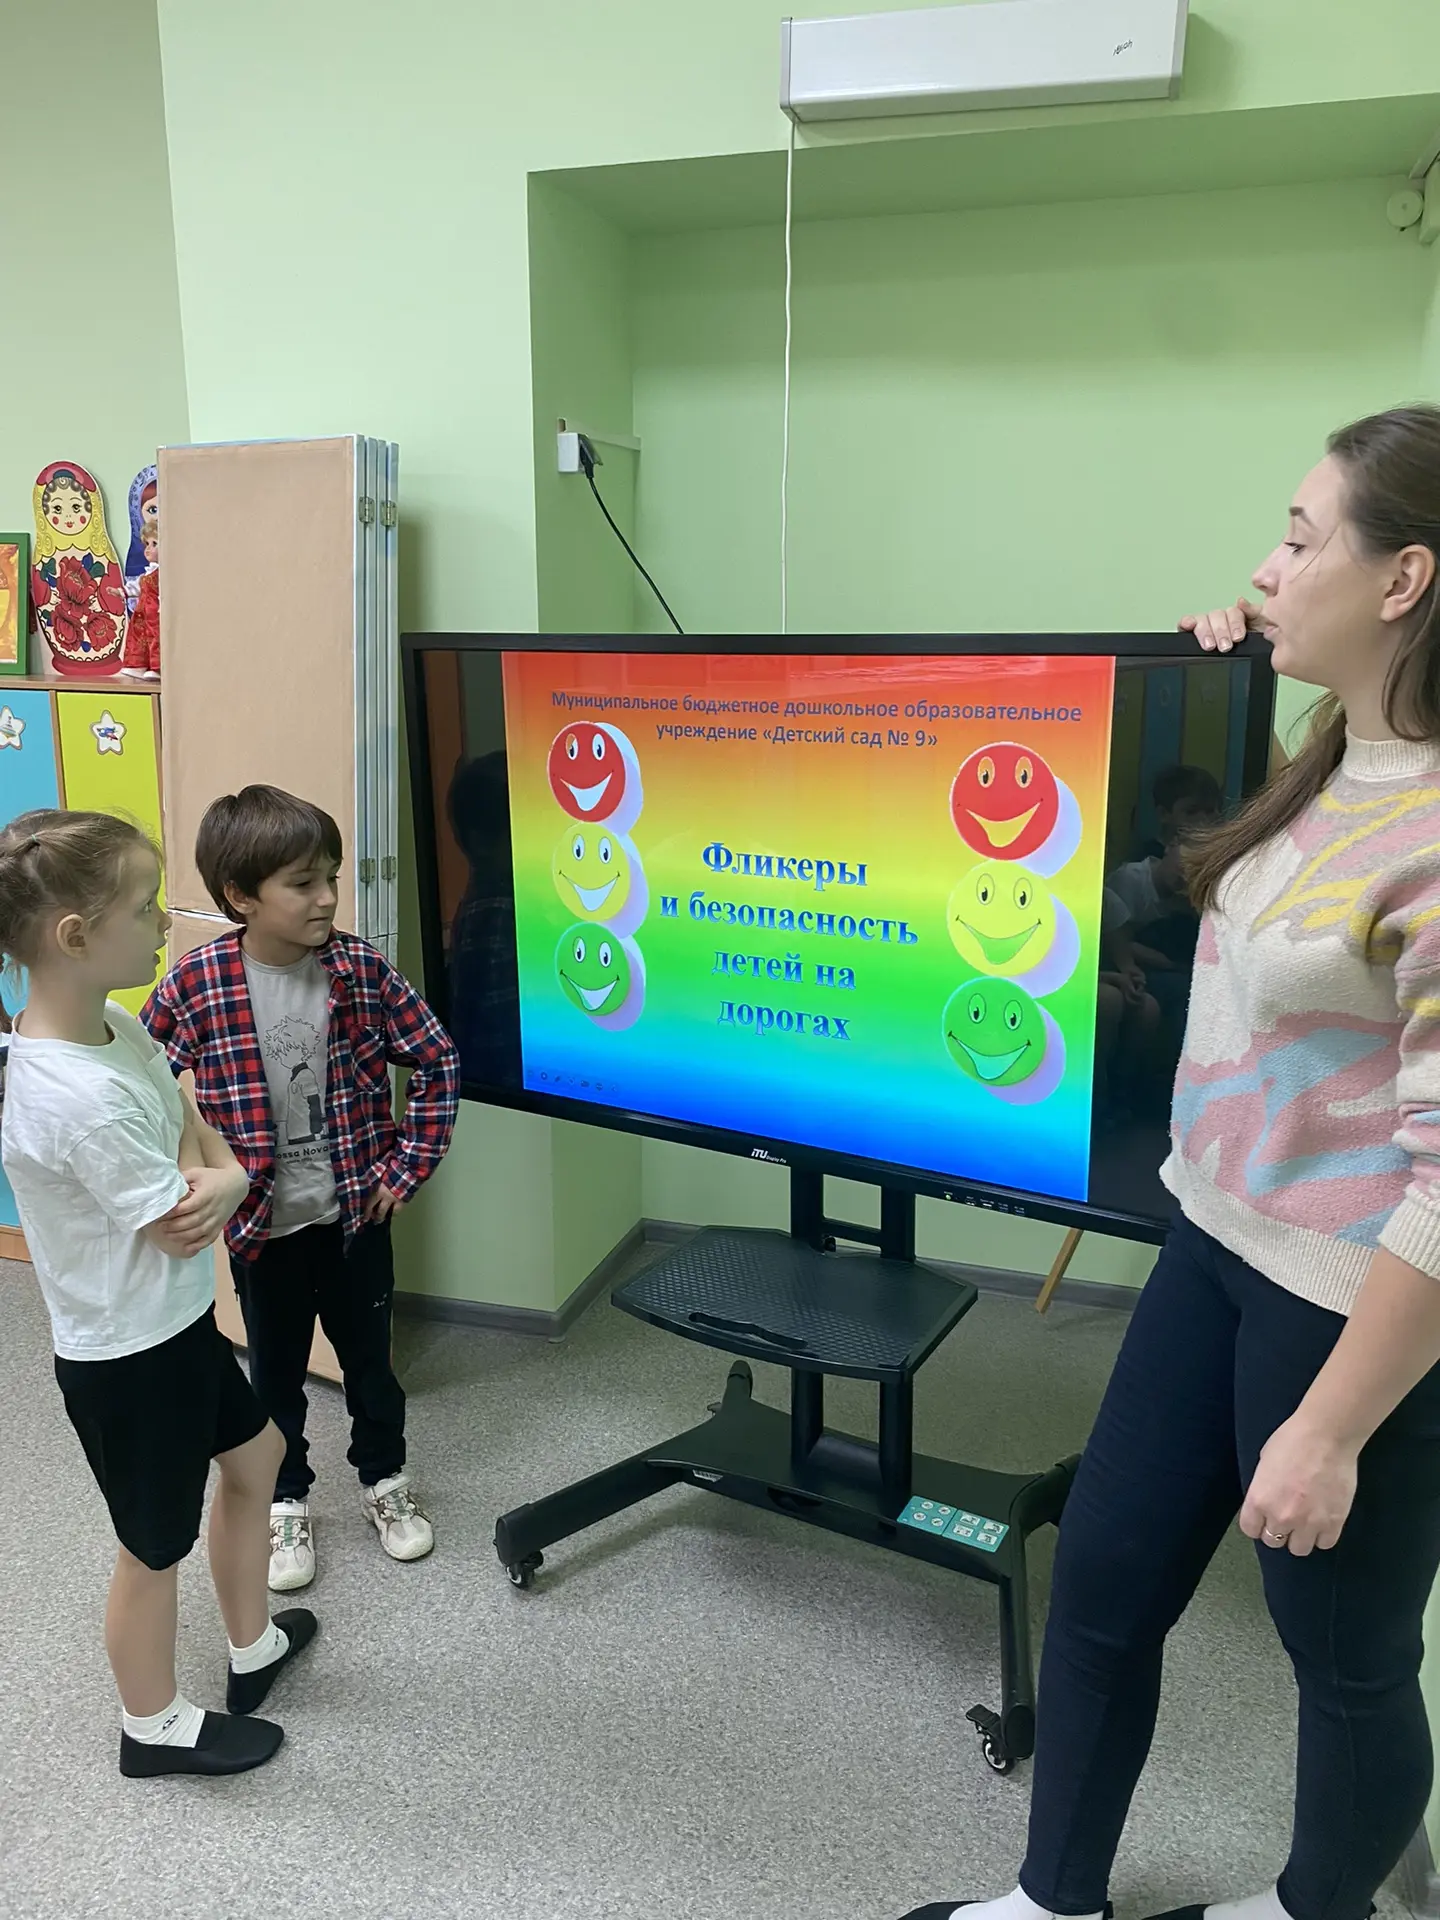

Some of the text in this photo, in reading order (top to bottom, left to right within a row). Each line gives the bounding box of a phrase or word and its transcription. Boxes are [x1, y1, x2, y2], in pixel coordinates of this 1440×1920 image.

[551, 691, 1082, 721] Муниципальное бюджетное дошкольное образовательное
[656, 723, 938, 749] учреждение «Детский сад № 9»
[701, 841, 868, 892] Фликеры
[659, 890, 919, 945] и безопасность
[711, 950, 856, 991] детей на
[717, 1000, 851, 1041] дорогах
[302, 1145, 329, 1157] Nova
